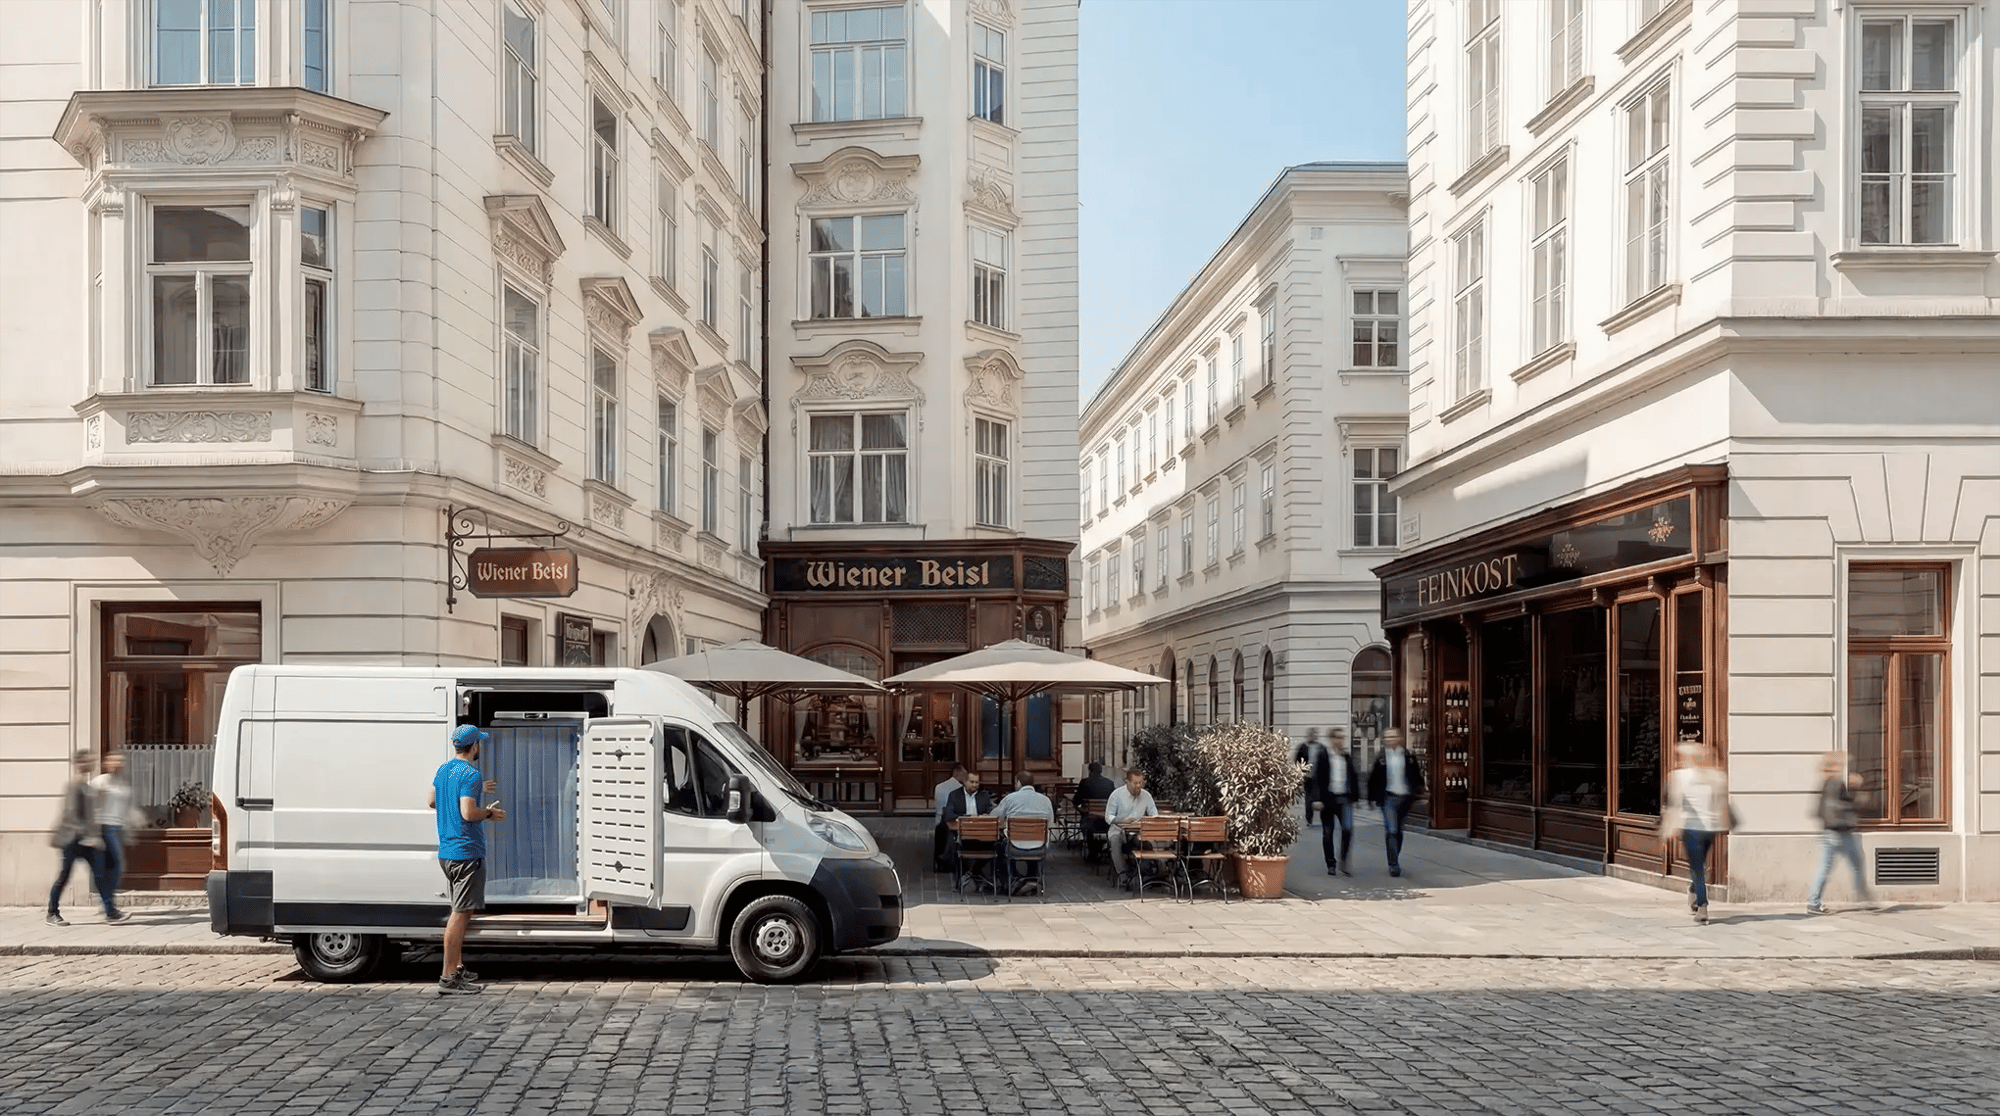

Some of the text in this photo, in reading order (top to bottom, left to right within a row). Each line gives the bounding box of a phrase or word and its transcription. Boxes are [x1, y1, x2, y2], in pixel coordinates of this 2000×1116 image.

[477, 561, 569, 581] Wiener Beisl
[806, 559, 990, 587] Wiener Beisl
[1417, 553, 1518, 607] FEINKOST
